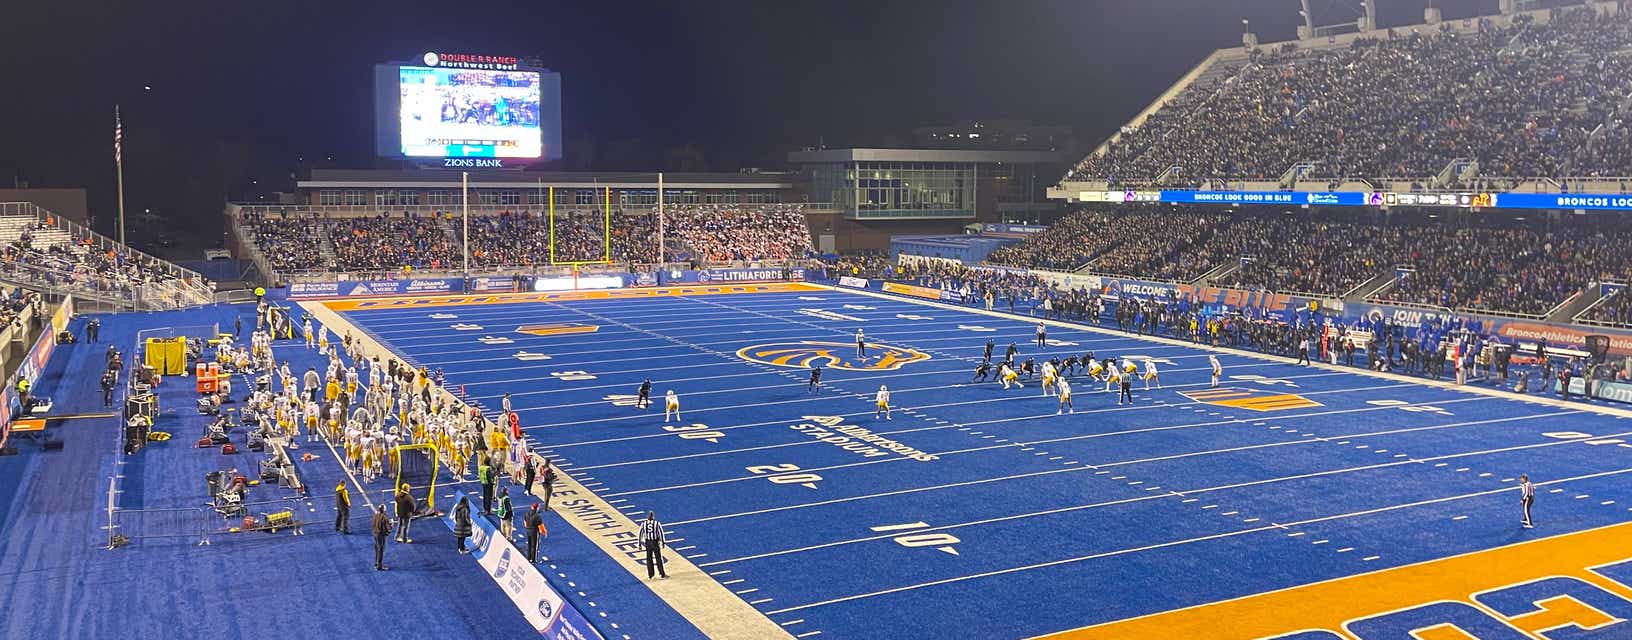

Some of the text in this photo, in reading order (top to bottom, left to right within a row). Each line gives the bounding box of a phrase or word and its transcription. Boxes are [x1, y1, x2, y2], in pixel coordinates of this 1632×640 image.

[444, 159, 502, 167] ZIONS BANK
[1557, 197, 1608, 206] BRONCOS
[1123, 284, 1168, 297] WELCOME
[789, 423, 889, 458] STADIUM
[745, 463, 823, 485] 20
[562, 498, 622, 531] SMITH
[870, 521, 961, 548] 10
